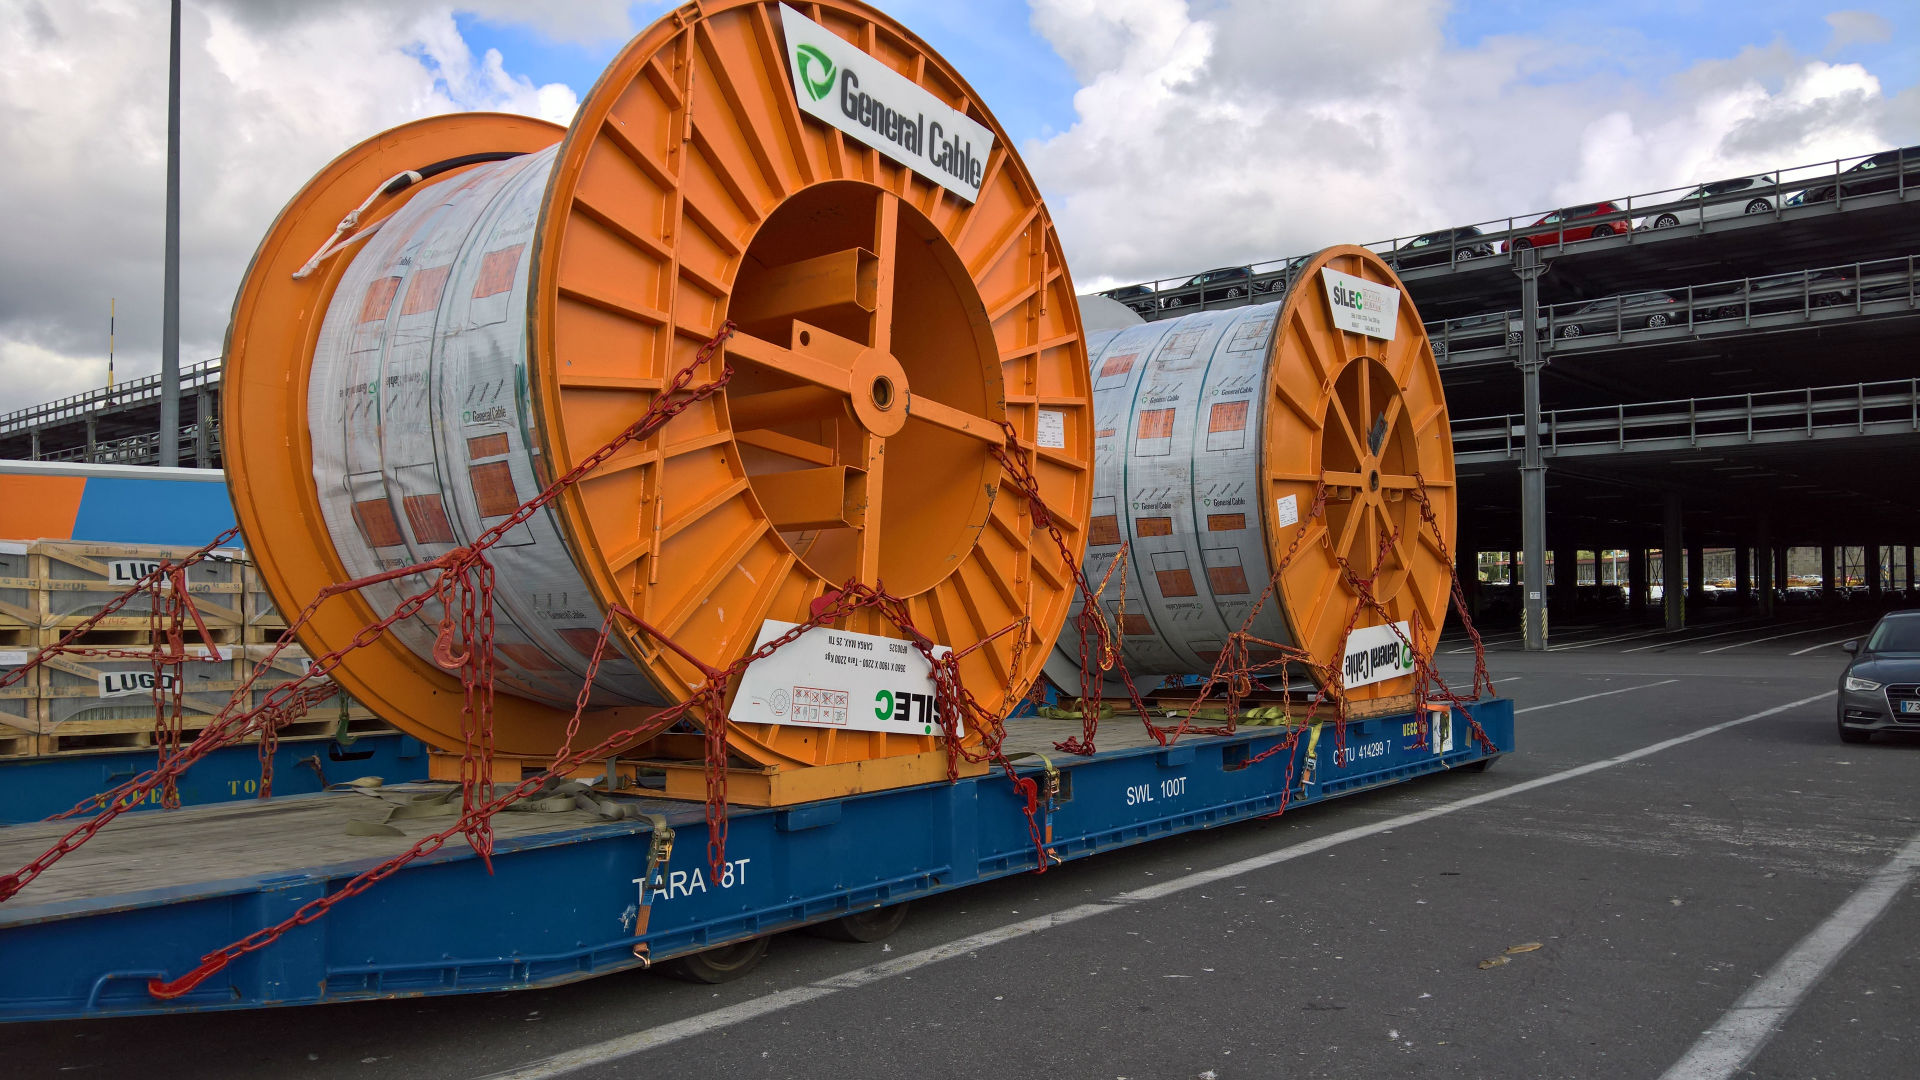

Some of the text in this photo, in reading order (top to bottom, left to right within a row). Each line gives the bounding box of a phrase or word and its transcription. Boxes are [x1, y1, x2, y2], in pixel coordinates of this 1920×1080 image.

[840, 68, 982, 190] General Cable
[1333, 281, 1363, 310] SILEC
[1141, 500, 1172, 510] General Cable
[1213, 497, 1246, 507] General Cable
[1345, 641, 1400, 684] General Cable
[1333, 746, 1355, 765] CTU
[1358, 741, 1384, 760] 414299
[1386, 739, 1391, 755] 7
[1126, 776, 1187, 806] SWL 100T
[632, 867, 707, 905] TARA
